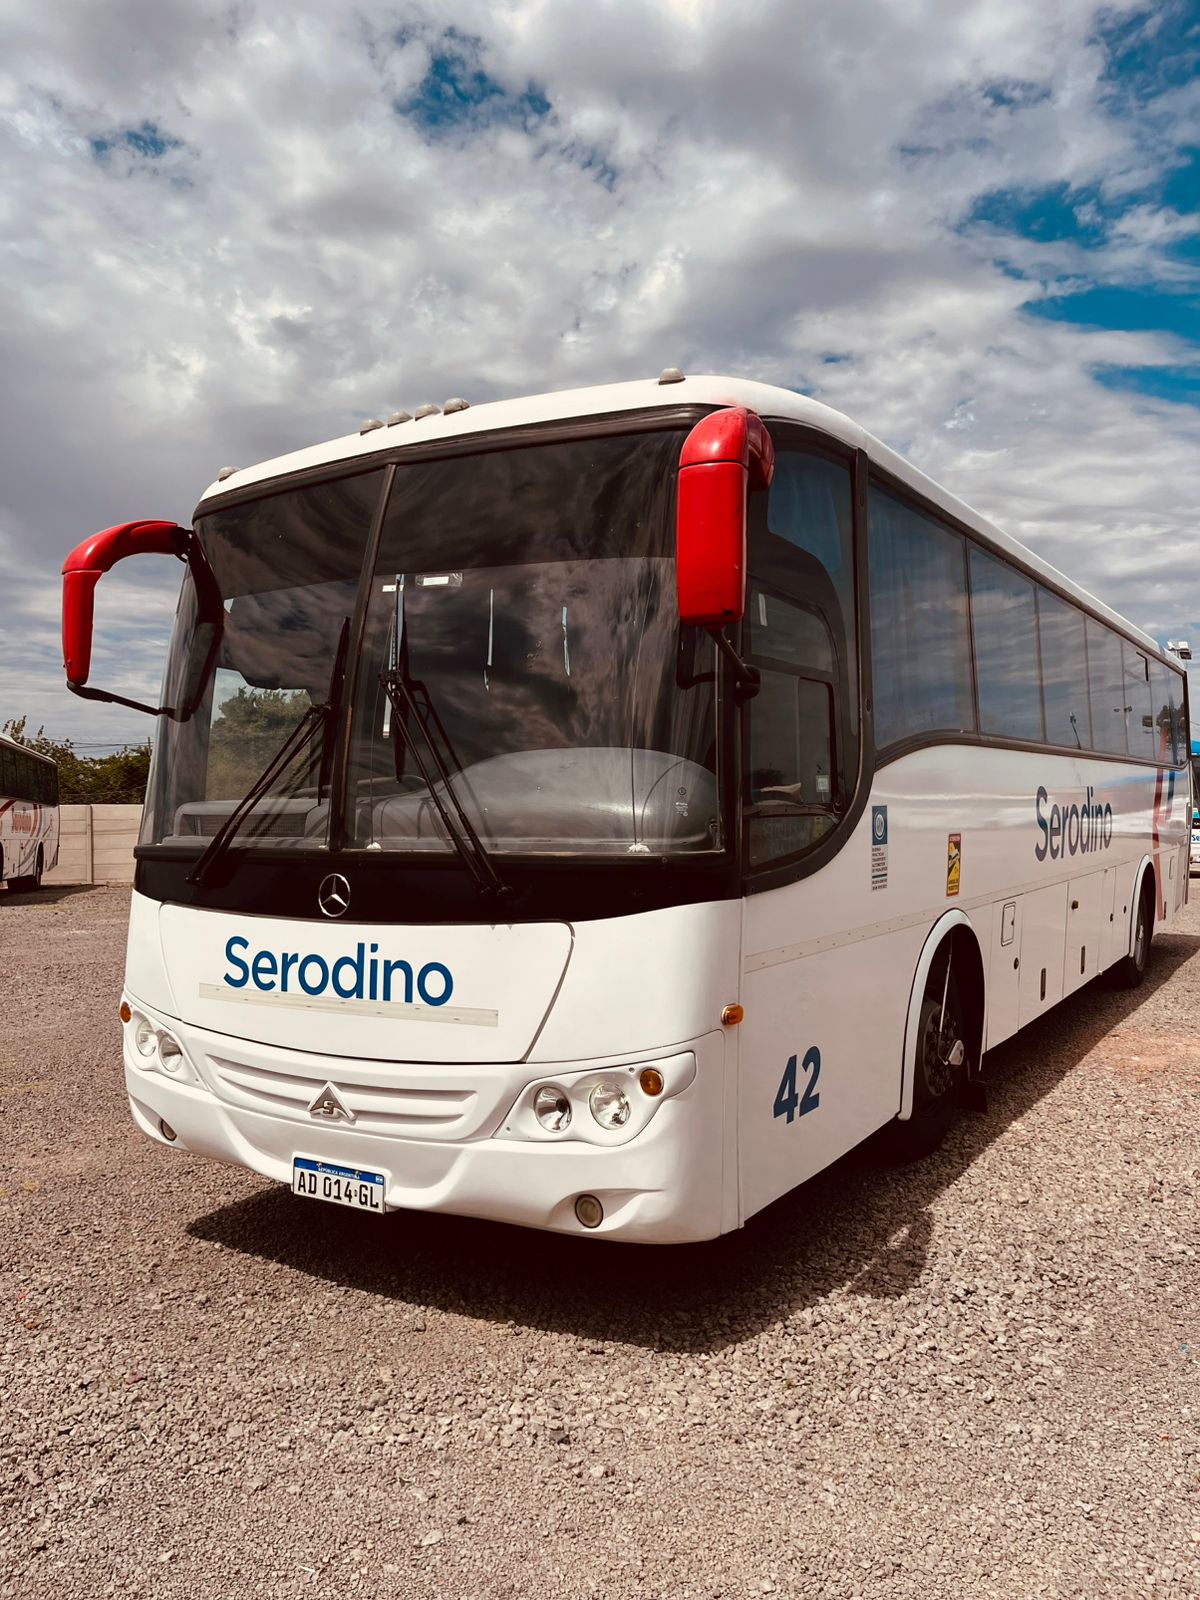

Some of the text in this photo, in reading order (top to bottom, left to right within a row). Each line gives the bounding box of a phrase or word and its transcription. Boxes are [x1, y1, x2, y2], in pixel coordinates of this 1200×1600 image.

[1035, 785, 1113, 862] Serodino
[223, 935, 454, 1007] Serodino
[773, 1045, 821, 1124] 42
[297, 1171, 379, 1209] AD 014 GL
